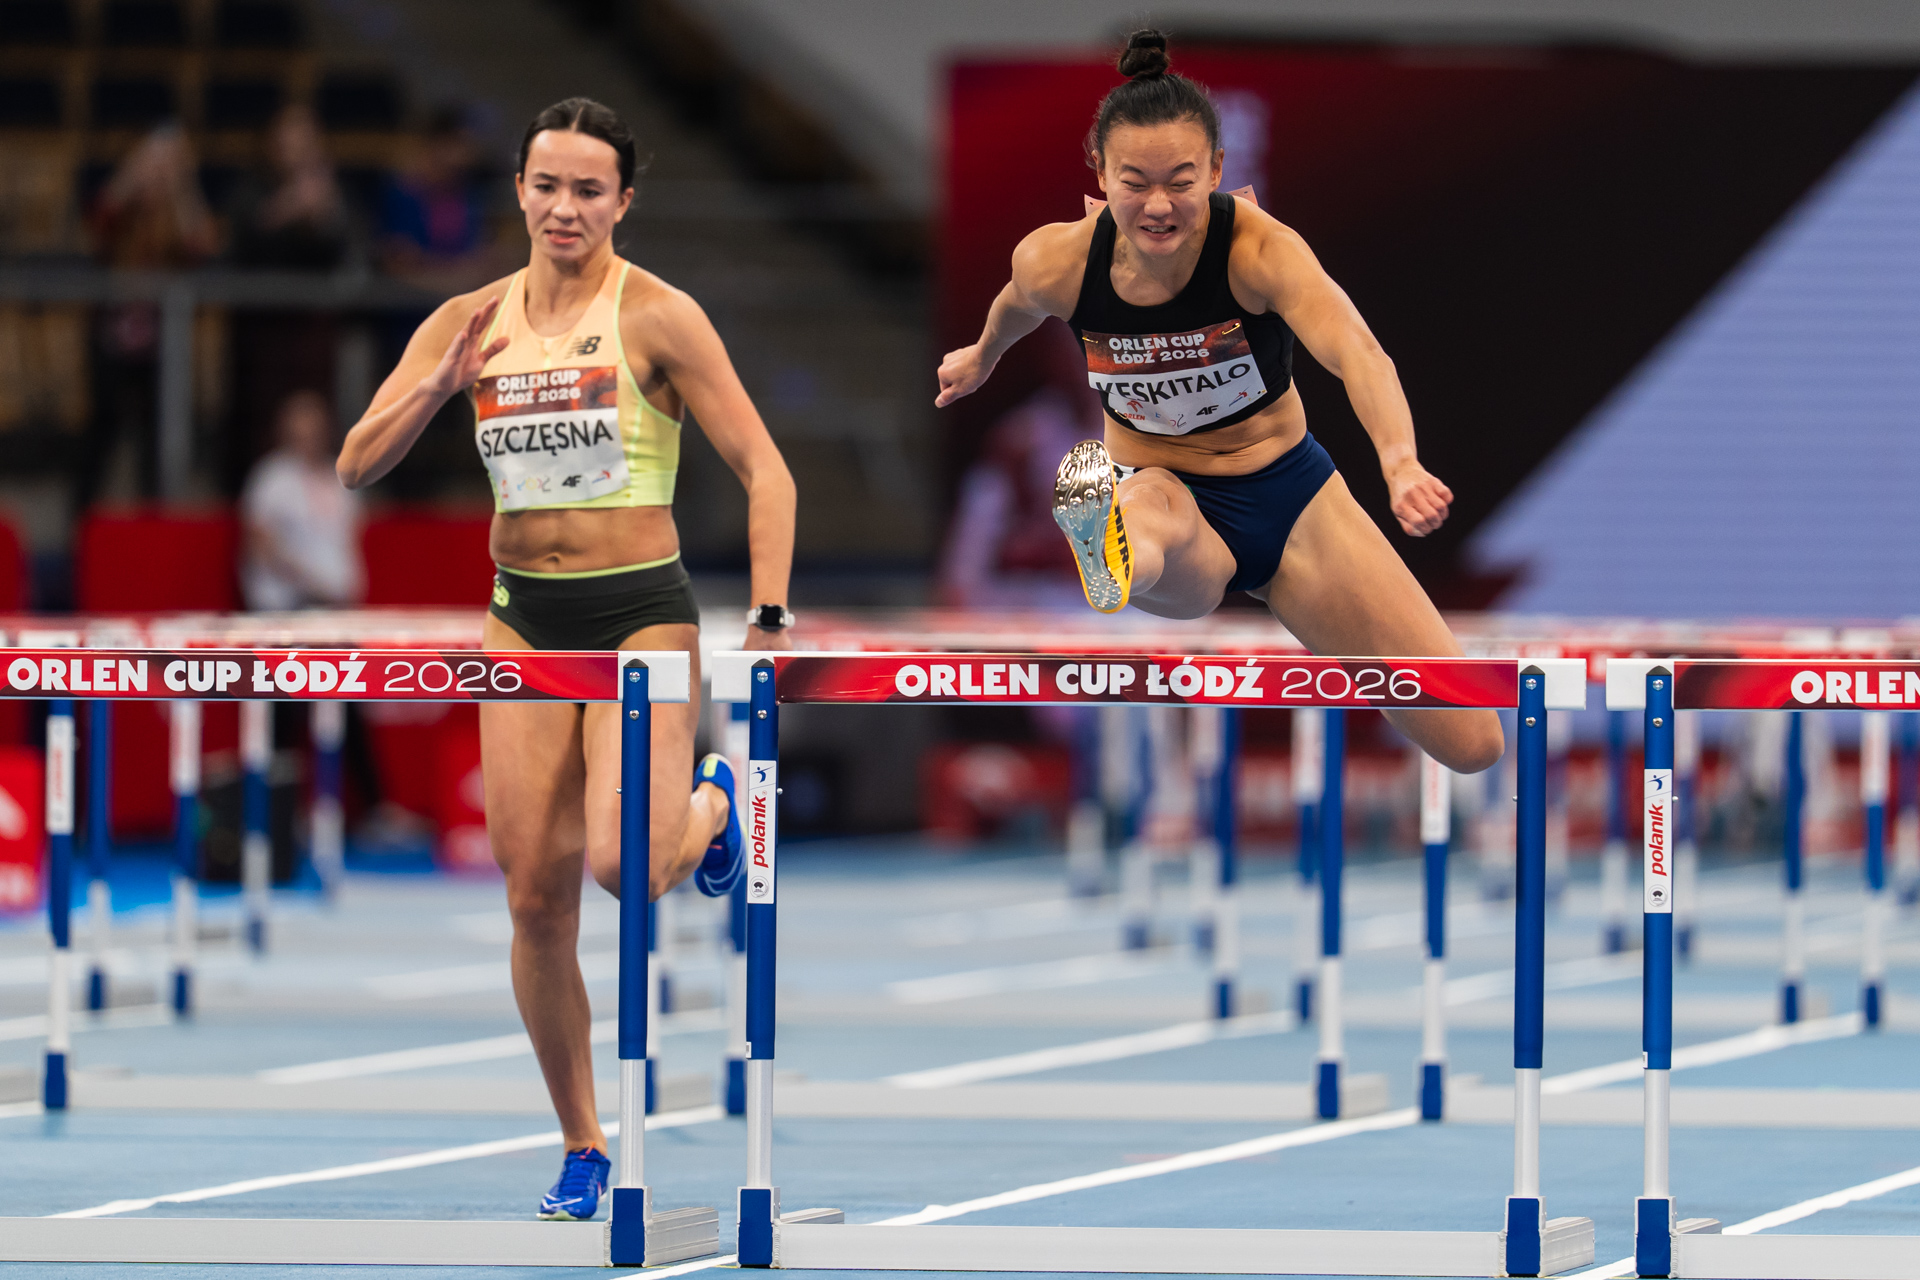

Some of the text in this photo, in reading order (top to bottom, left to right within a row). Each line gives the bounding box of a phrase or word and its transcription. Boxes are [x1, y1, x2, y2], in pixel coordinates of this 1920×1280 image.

[1109, 333, 1205, 350] ORLEN CUP
[1112, 348, 1210, 364] ŁÓDŹ 2026
[496, 369, 581, 391] ORLEN CUP
[497, 387, 581, 406] ŁÓDŹ 2026
[1196, 404, 1219, 416] 4F
[481, 419, 613, 457] SZCZĘSNA
[561, 475, 582, 488] 4F
[7, 652, 523, 693] ORLEN CUP ŁÓDŹ 2026
[895, 656, 1422, 700] ORLEN CUP ŁÓDŹ 2026
[751, 795, 769, 868] polanik
[1648, 804, 1667, 877] polanik
